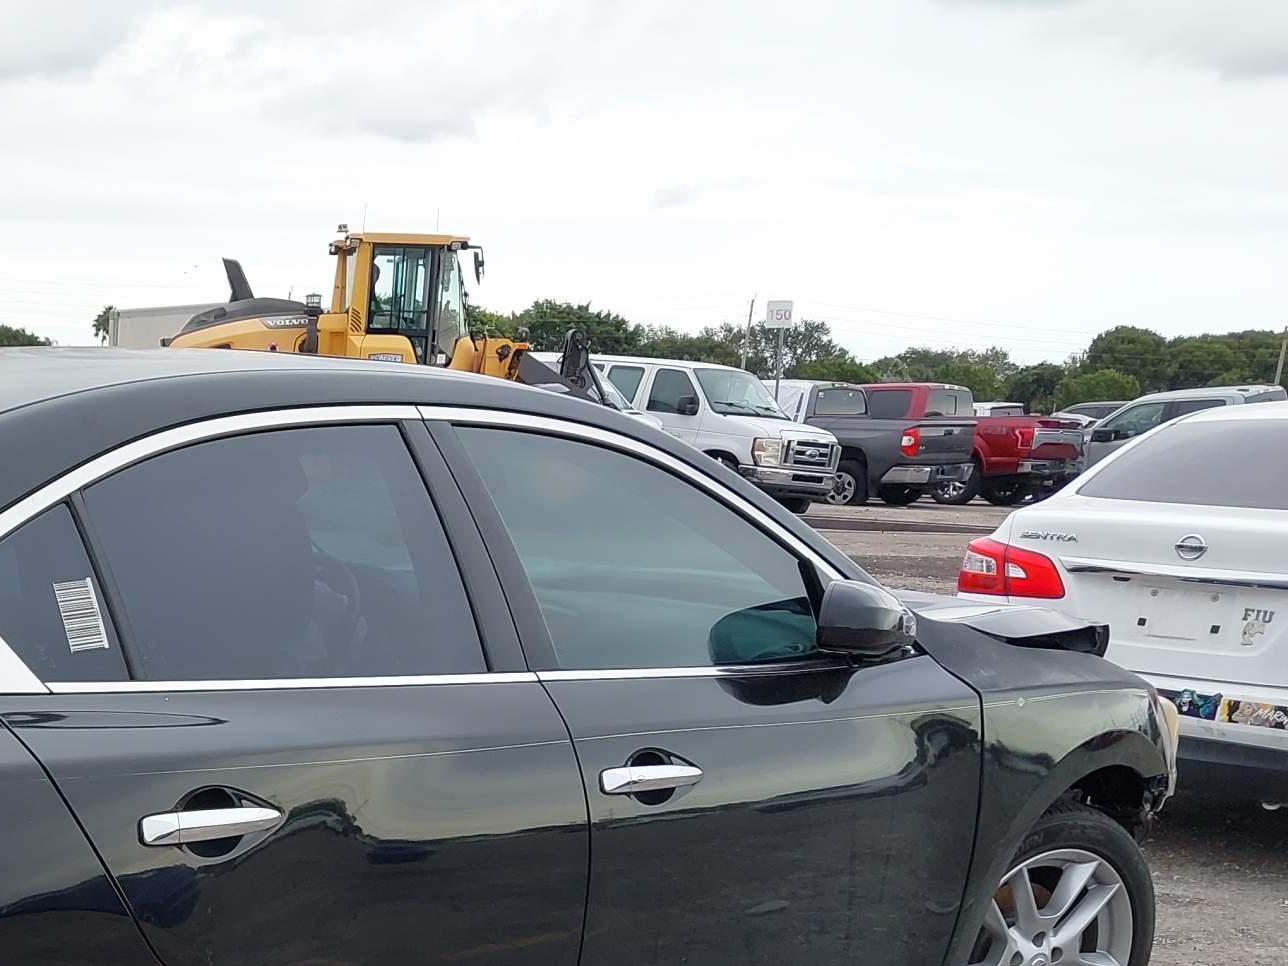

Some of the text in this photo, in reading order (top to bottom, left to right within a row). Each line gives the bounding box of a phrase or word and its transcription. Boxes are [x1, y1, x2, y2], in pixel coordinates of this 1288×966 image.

[769, 309, 792, 321] 150
[266, 318, 309, 326] VOLVO
[1019, 531, 1079, 543] SENTRA
[1242, 607, 1275, 624] FIU
